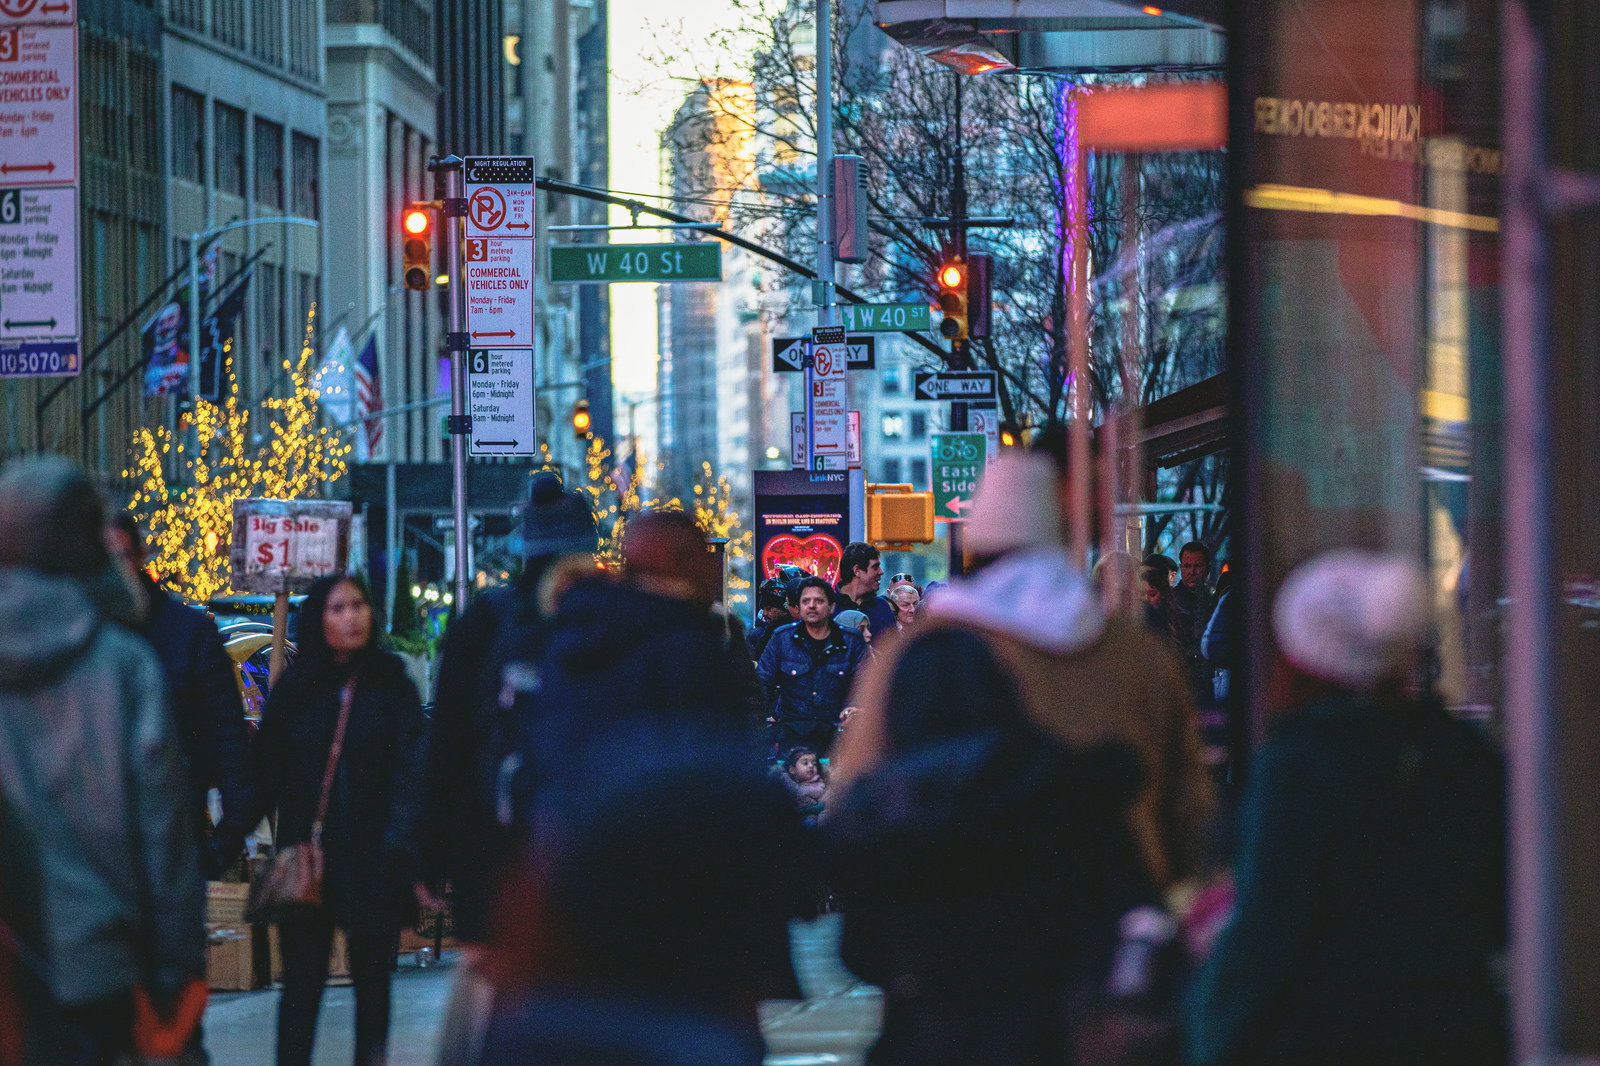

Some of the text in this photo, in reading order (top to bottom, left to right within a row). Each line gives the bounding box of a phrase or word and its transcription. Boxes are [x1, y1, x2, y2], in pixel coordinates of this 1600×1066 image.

[0, 31, 12, 60] 3
[45, 86, 70, 100] ONLY
[1, 191, 17, 222] 6
[471, 239, 483, 260] 3
[586, 250, 683, 275] W 40 St
[470, 267, 521, 278] COMMERCIAL
[470, 279, 529, 290] VEHICLES ONLY
[470, 296, 493, 305] Monday
[497, 295, 516, 305] Friday
[471, 305, 484, 314] 7am
[488, 305, 503, 315] 6pm
[860, 306, 925, 328] W 40 ST
[1, 351, 60, 373] 105070
[473, 351, 485, 373] 6
[472, 380, 496, 389] Monday
[500, 379, 520, 389] Friday
[816, 382, 822, 396] 3
[927, 380, 986, 393] ONE WAY
[472, 390, 486, 399] 6pm
[491, 389, 515, 399] Midnight
[473, 404, 500, 414] Saturday
[473, 414, 487, 422] 8am
[491, 413, 515, 423] Midnight
[816, 456, 823, 470] 6
[810, 474, 845, 482] LinkNYC
[942, 466, 977, 477] East
[942, 481, 977, 493] Side
[282, 519, 319, 533] Sale
[257, 538, 292, 566] $1
